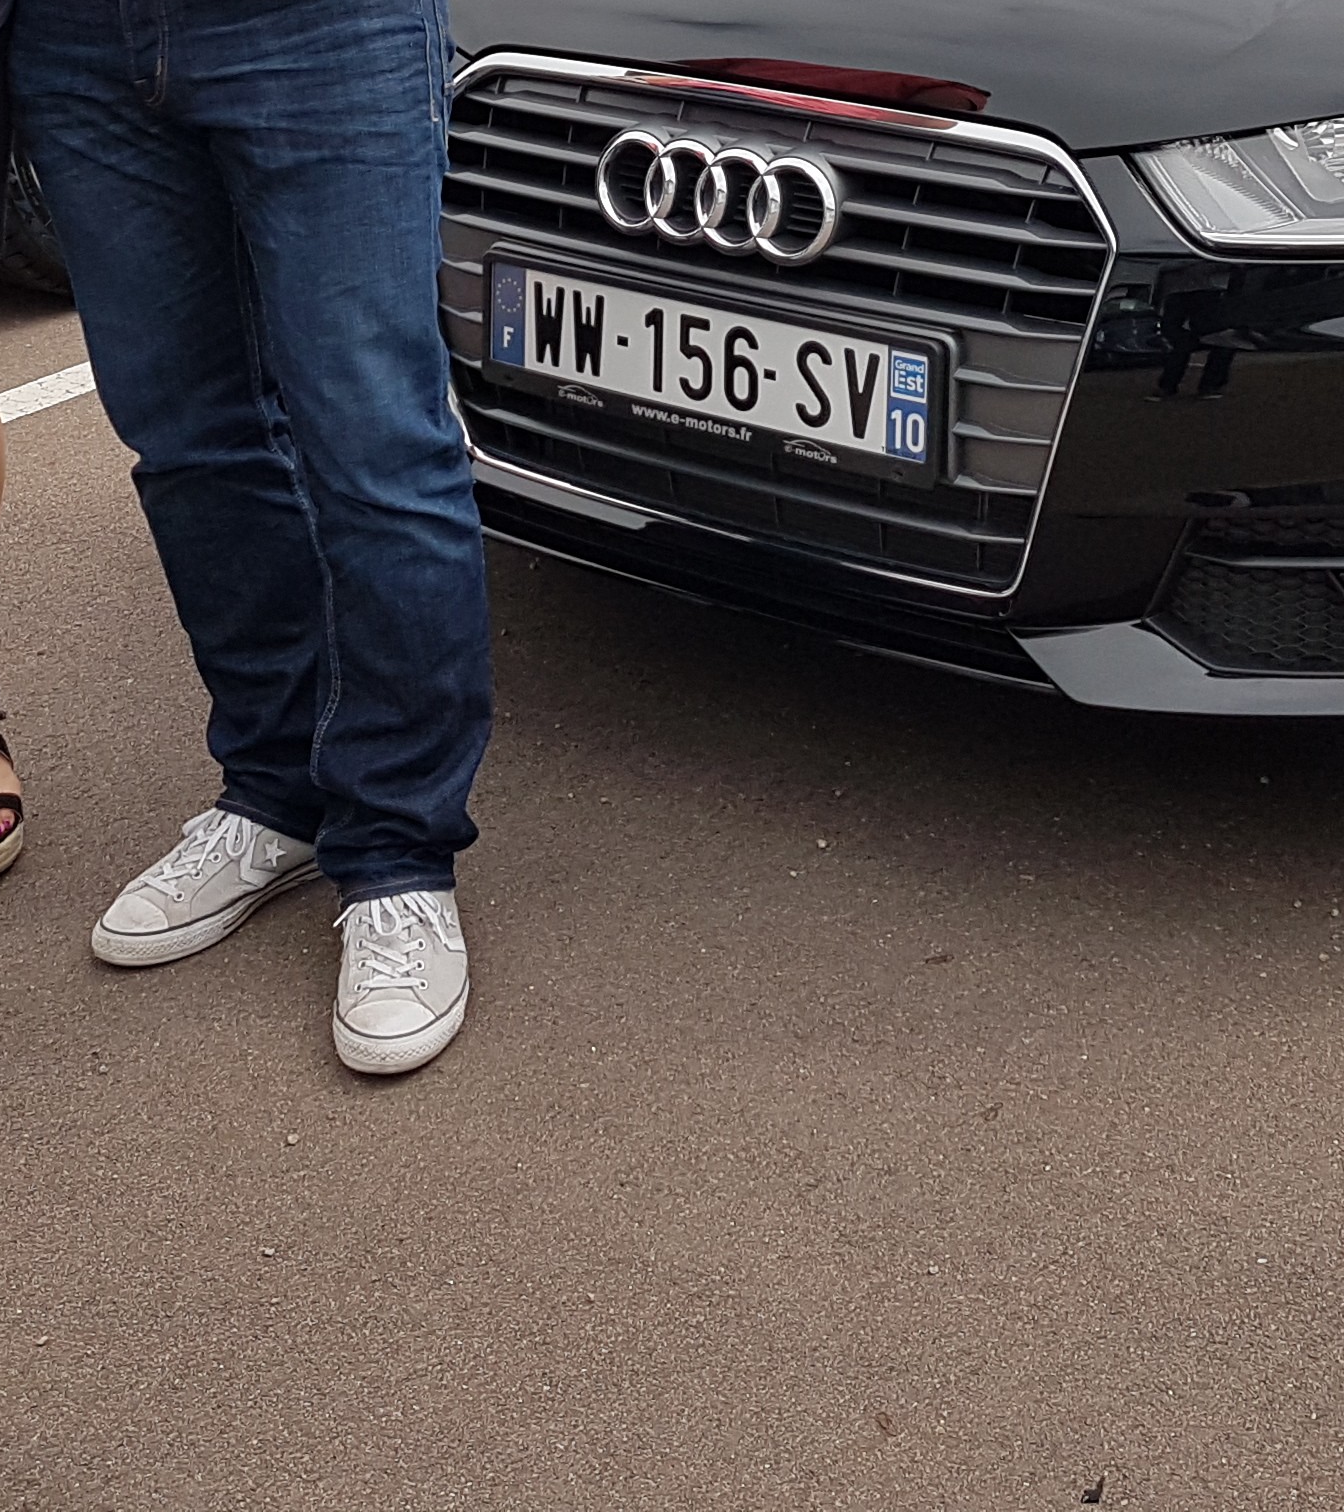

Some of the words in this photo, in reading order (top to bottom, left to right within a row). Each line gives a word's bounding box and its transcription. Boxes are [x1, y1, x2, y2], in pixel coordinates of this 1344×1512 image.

[502, 325, 514, 348] F
[894, 359, 925, 374] Grand
[894, 369, 924, 393] Est
[631, 403, 753, 442] www.e-motors.fr
[890, 409, 926, 454] 10
